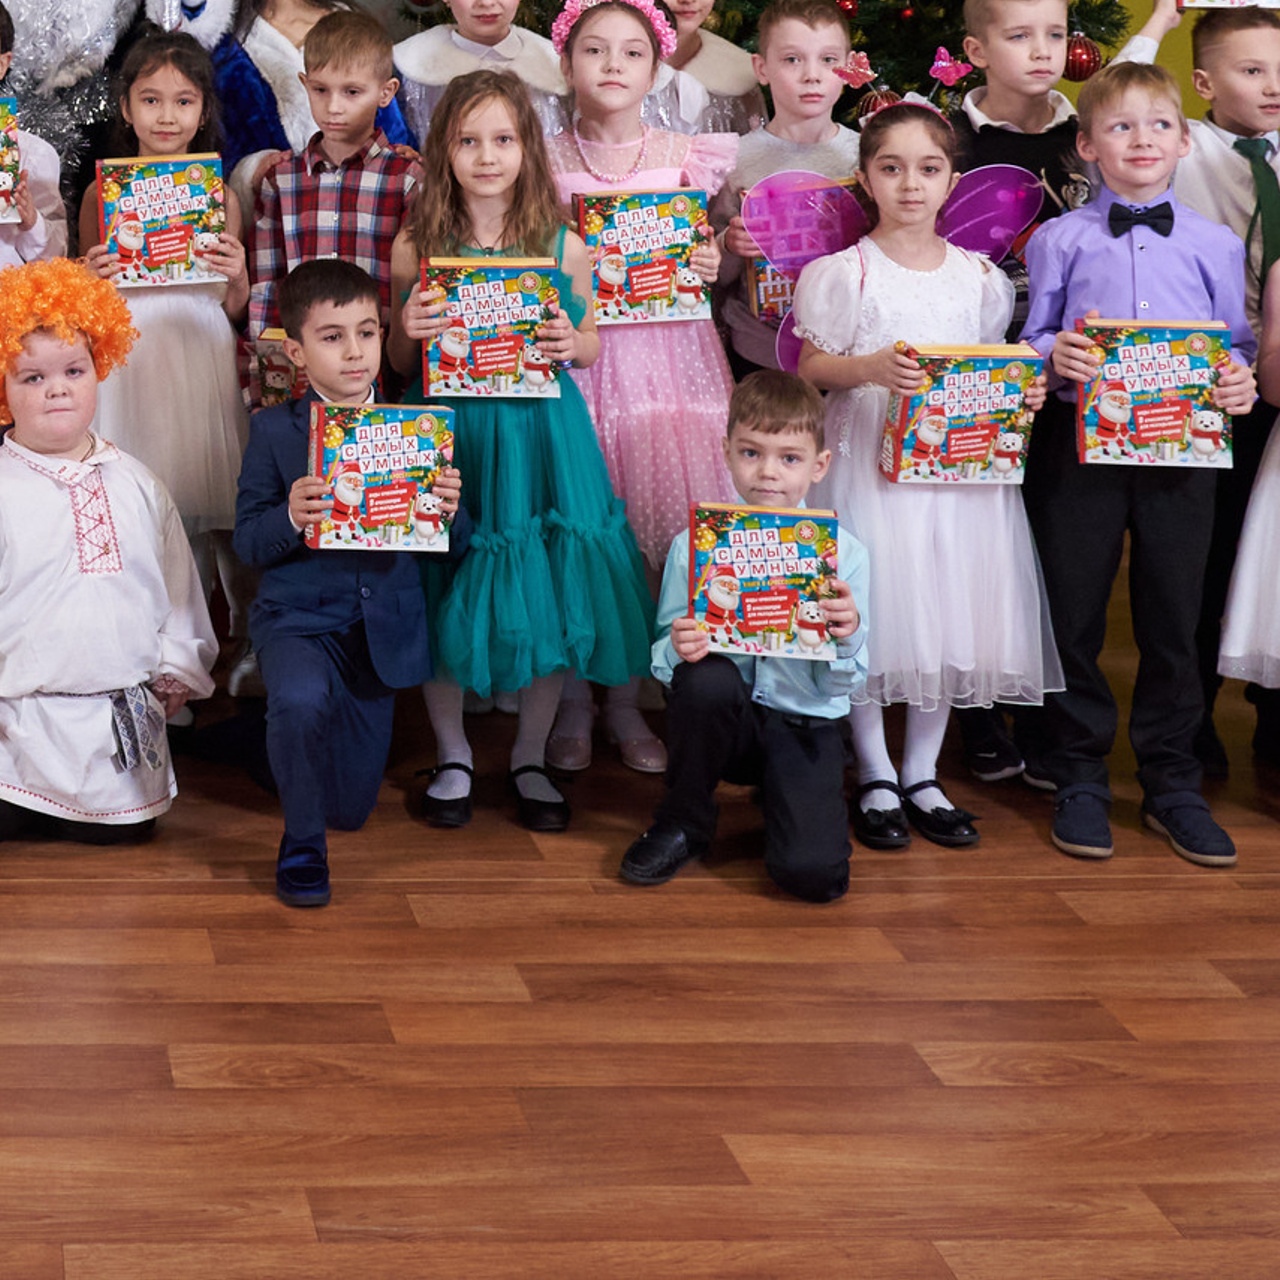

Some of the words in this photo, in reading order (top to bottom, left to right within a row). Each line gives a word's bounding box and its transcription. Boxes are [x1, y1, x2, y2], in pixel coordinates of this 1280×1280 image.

[134, 176, 172, 192] ДЛЯ
[123, 187, 188, 208] САМЫХ
[140, 199, 204, 219] УМНЫХ
[617, 208, 655, 225] ДЛЯ
[605, 220, 671, 241] САМЫХ
[623, 231, 687, 252] УМНЫХ
[461, 282, 501, 298] ДЛЯ
[450, 295, 518, 313] САМЫХ
[467, 307, 536, 326] УМНЫХ
[1122, 344, 1166, 359] ДЛЯ
[1108, 357, 1186, 376] САМЫХ
[946, 372, 987, 386] ДЛЯ
[1128, 372, 1207, 389] УМНЫХ
[932, 385, 1002, 402] САМЫХ
[948, 397, 1016, 414] УМНЫХ
[358, 425, 399, 440] ДЛЯ
[345, 438, 414, 457] САМЫХ
[362, 453, 432, 470] УМНЫХ
[732, 531, 776, 544] ДЛЯ
[718, 546, 794, 560] САМЫХ
[737, 560, 814, 575] УМНЫХ
